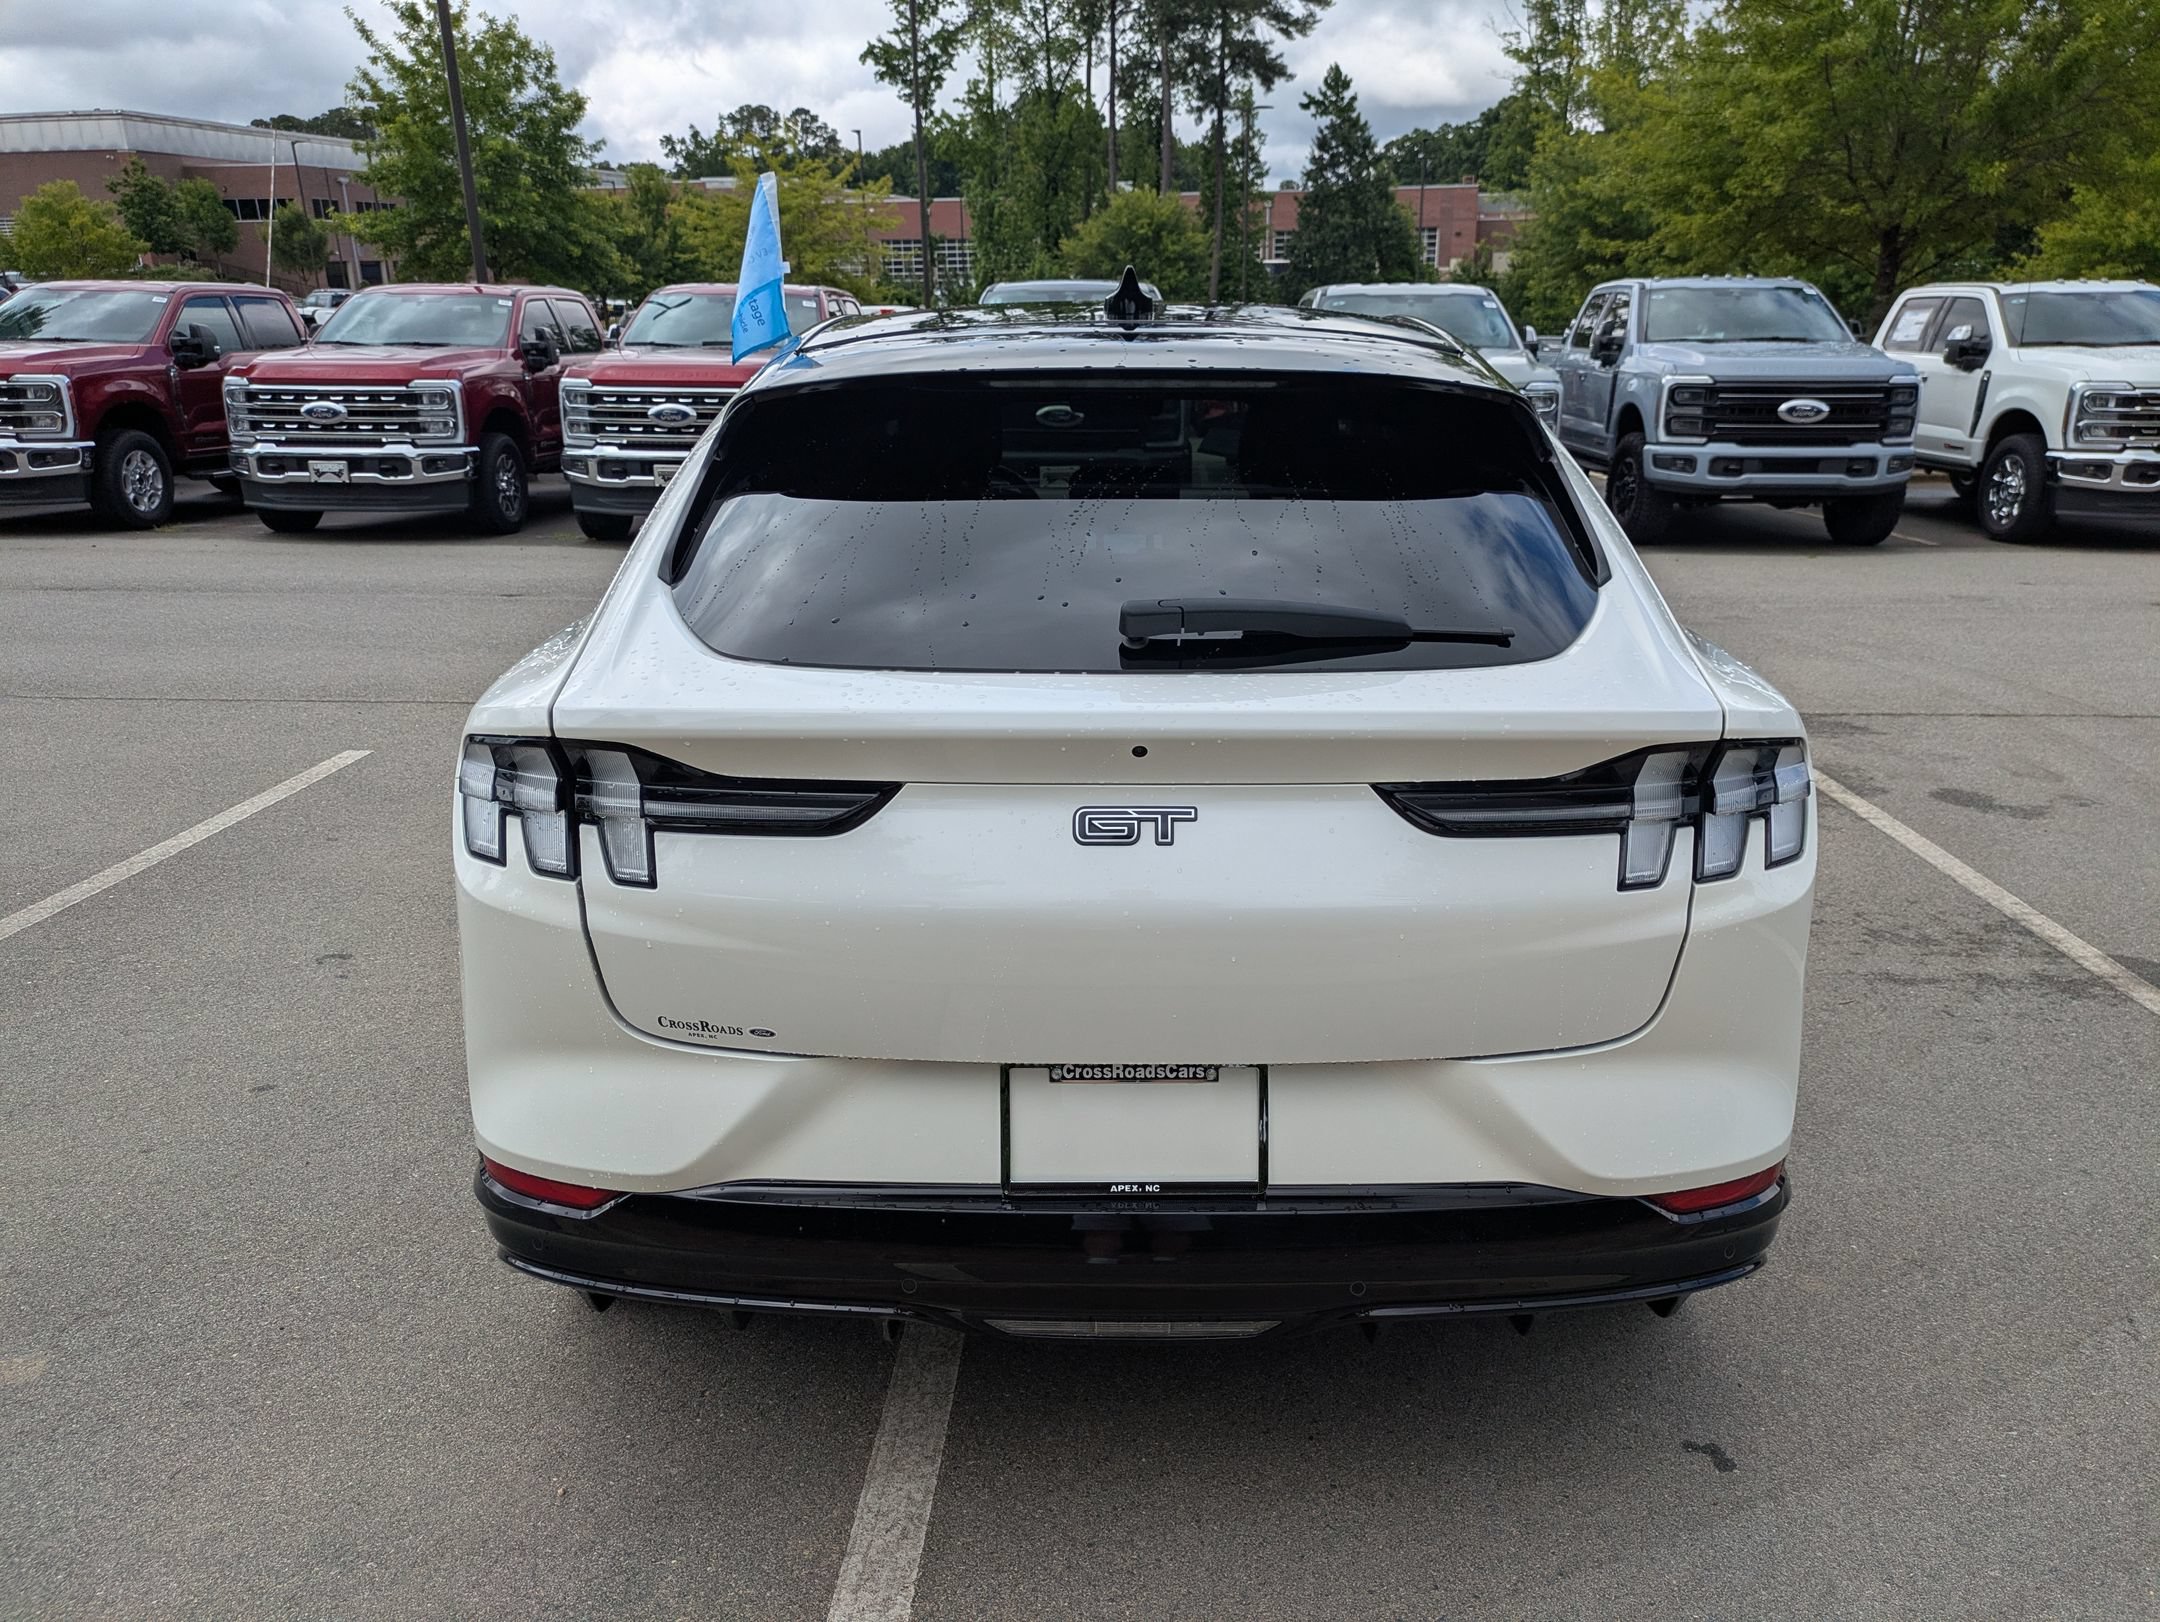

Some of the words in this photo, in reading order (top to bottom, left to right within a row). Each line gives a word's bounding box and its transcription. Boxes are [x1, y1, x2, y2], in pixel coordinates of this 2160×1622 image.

[1072, 806, 1198, 846] GT
[1062, 1064, 1205, 1079] CrossRoadsCars
[1110, 1184, 1142, 1193] APEX,
[1145, 1184, 1160, 1193] NC
